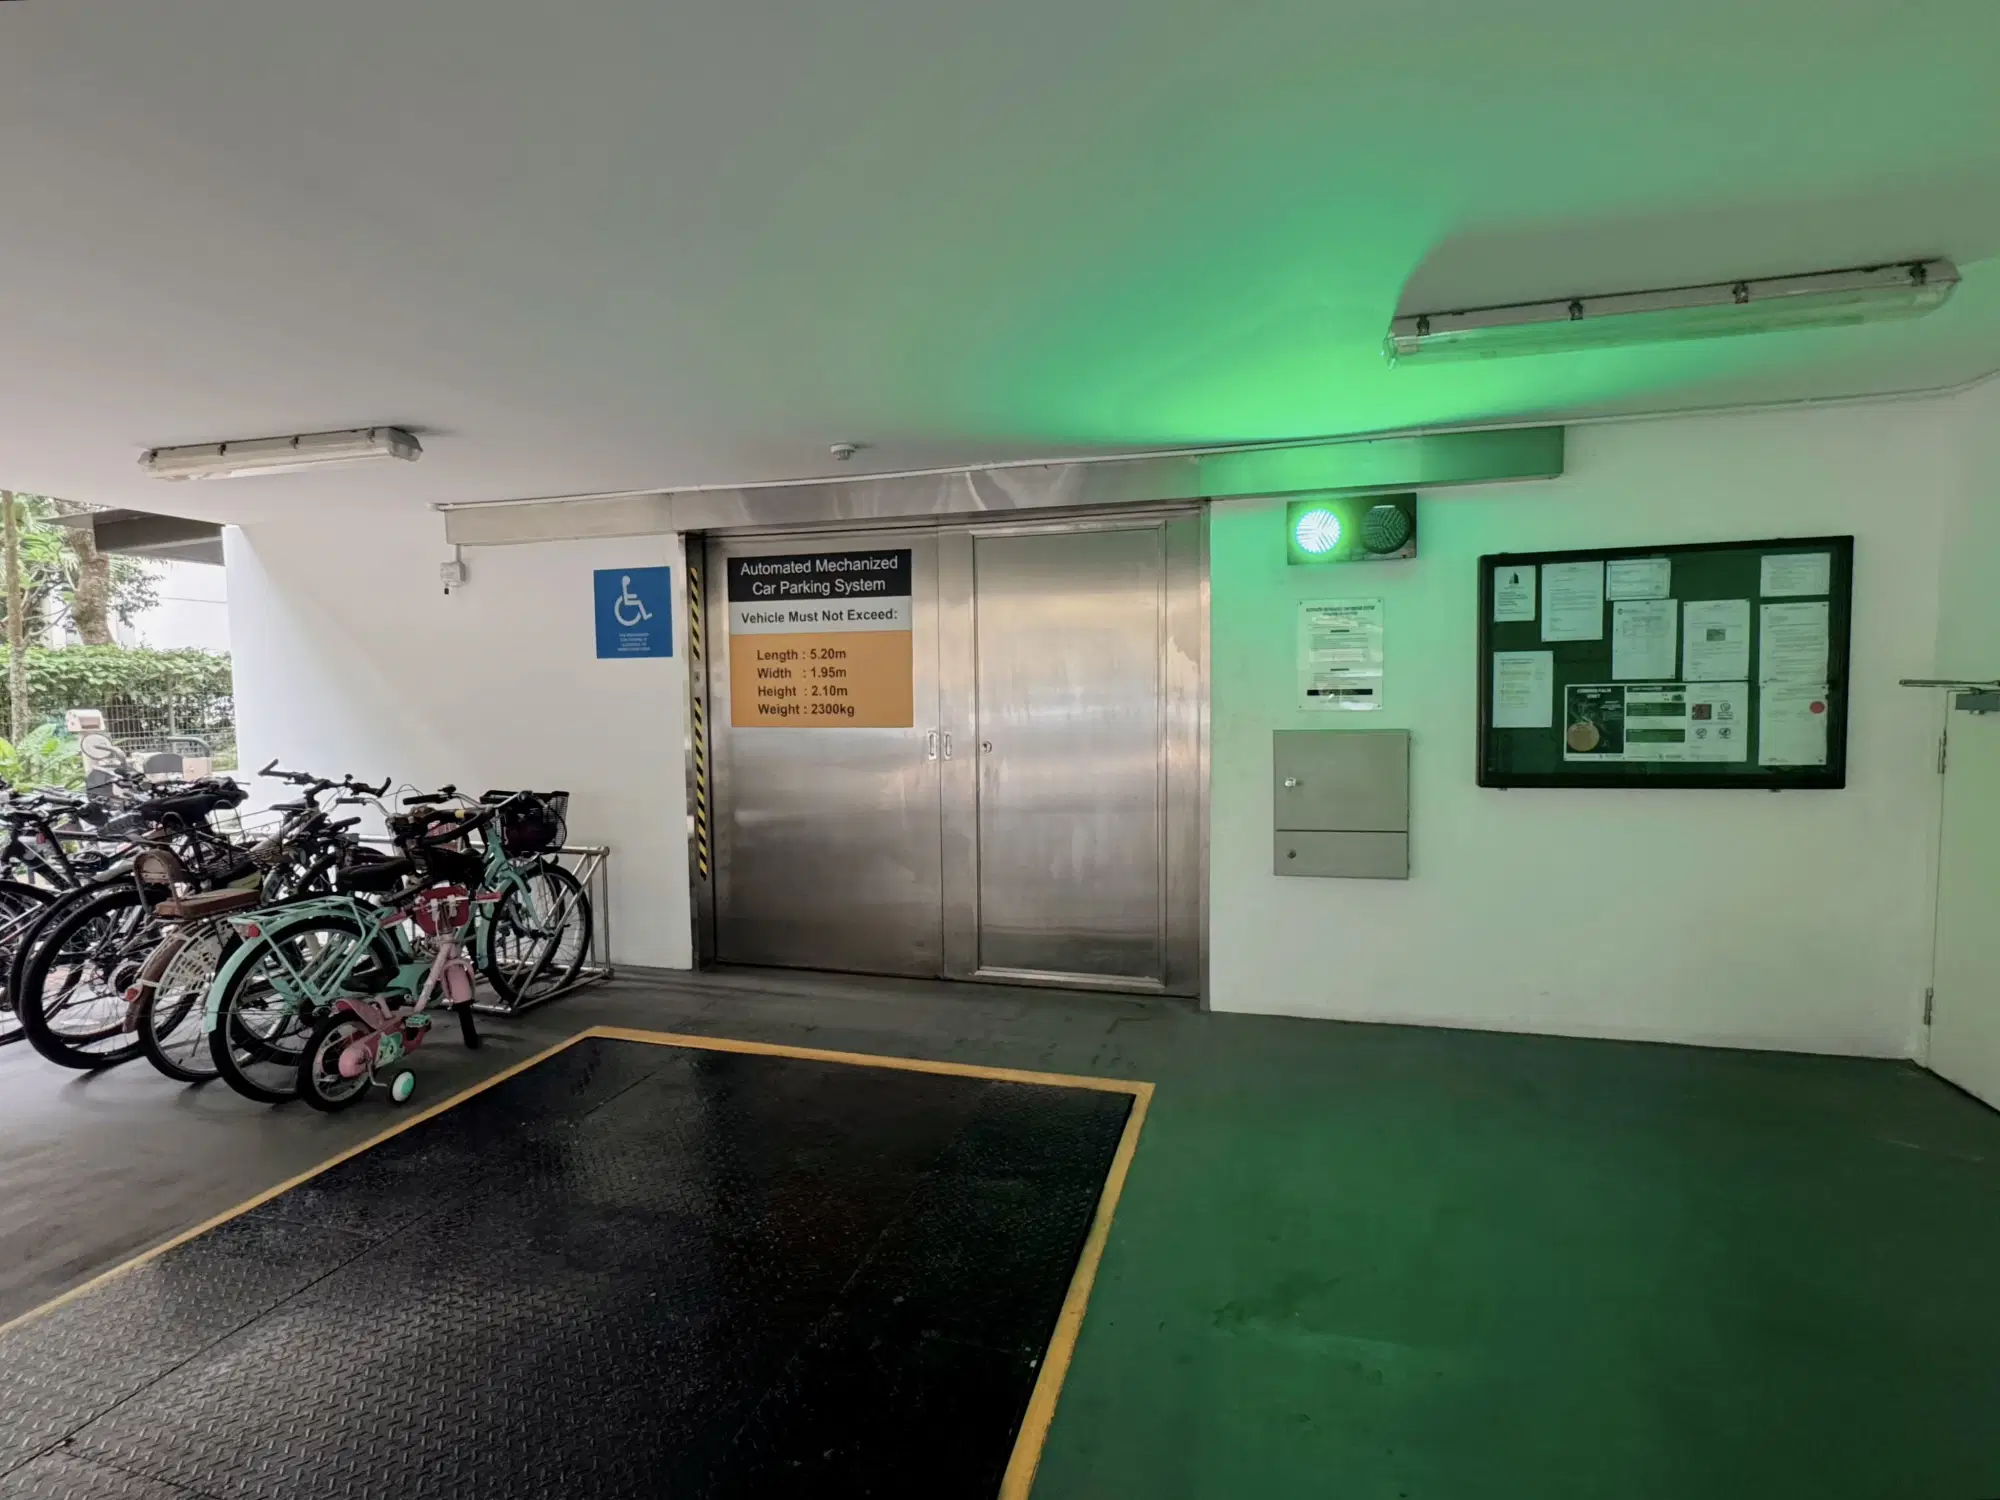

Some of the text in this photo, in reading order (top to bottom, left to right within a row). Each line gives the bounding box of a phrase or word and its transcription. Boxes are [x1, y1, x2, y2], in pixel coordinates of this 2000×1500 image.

[740, 555, 898, 576] Automated Mechanized
[752, 578, 886, 596] Car Parking System
[741, 608, 898, 624] Vehicle Must Not Exceed:
[756, 649, 799, 663] Length
[810, 647, 847, 660] 5.20m
[756, 667, 792, 679] Width
[810, 666, 847, 678] 1.95m
[757, 685, 797, 700] Height
[811, 684, 848, 697] 2.10m
[757, 703, 800, 718] Weight
[810, 703, 855, 718] 2300kg
